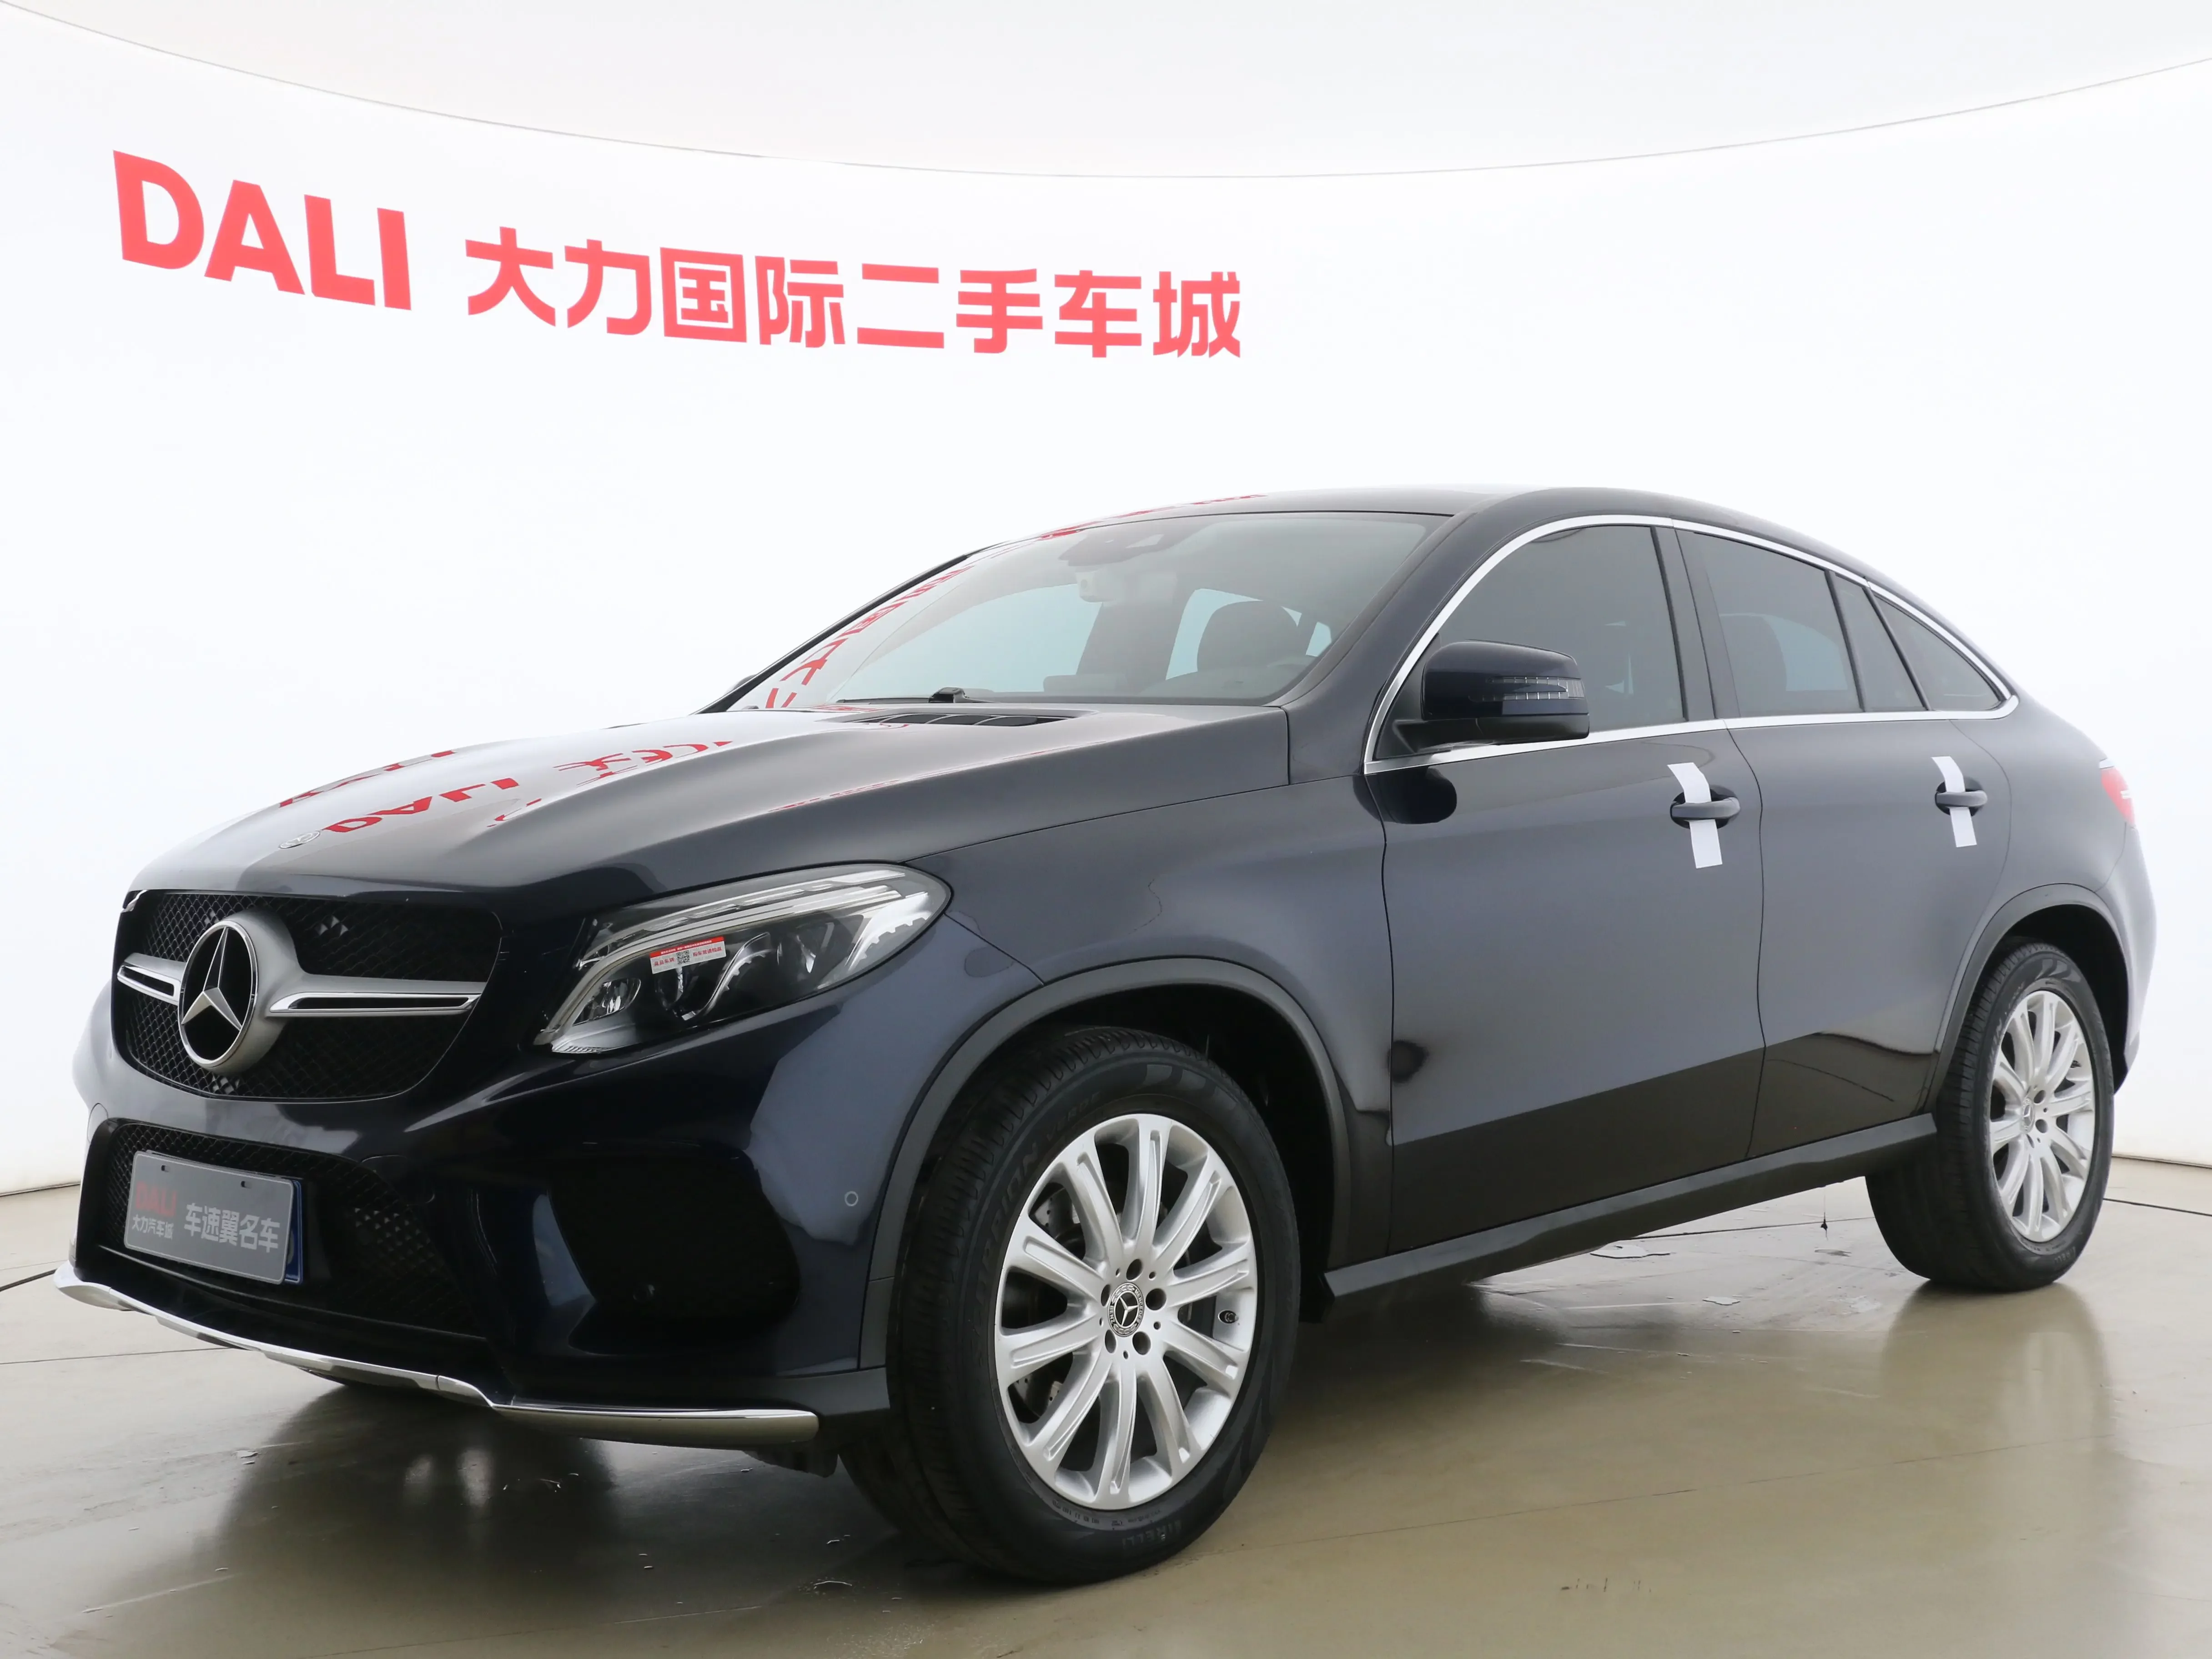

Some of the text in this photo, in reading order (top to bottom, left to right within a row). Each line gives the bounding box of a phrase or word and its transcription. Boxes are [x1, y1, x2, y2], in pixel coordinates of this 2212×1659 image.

[113, 151, 411, 310] DALI
[466, 227, 1240, 358] 大力国际二手车城
[136, 1182, 177, 1217] DALI
